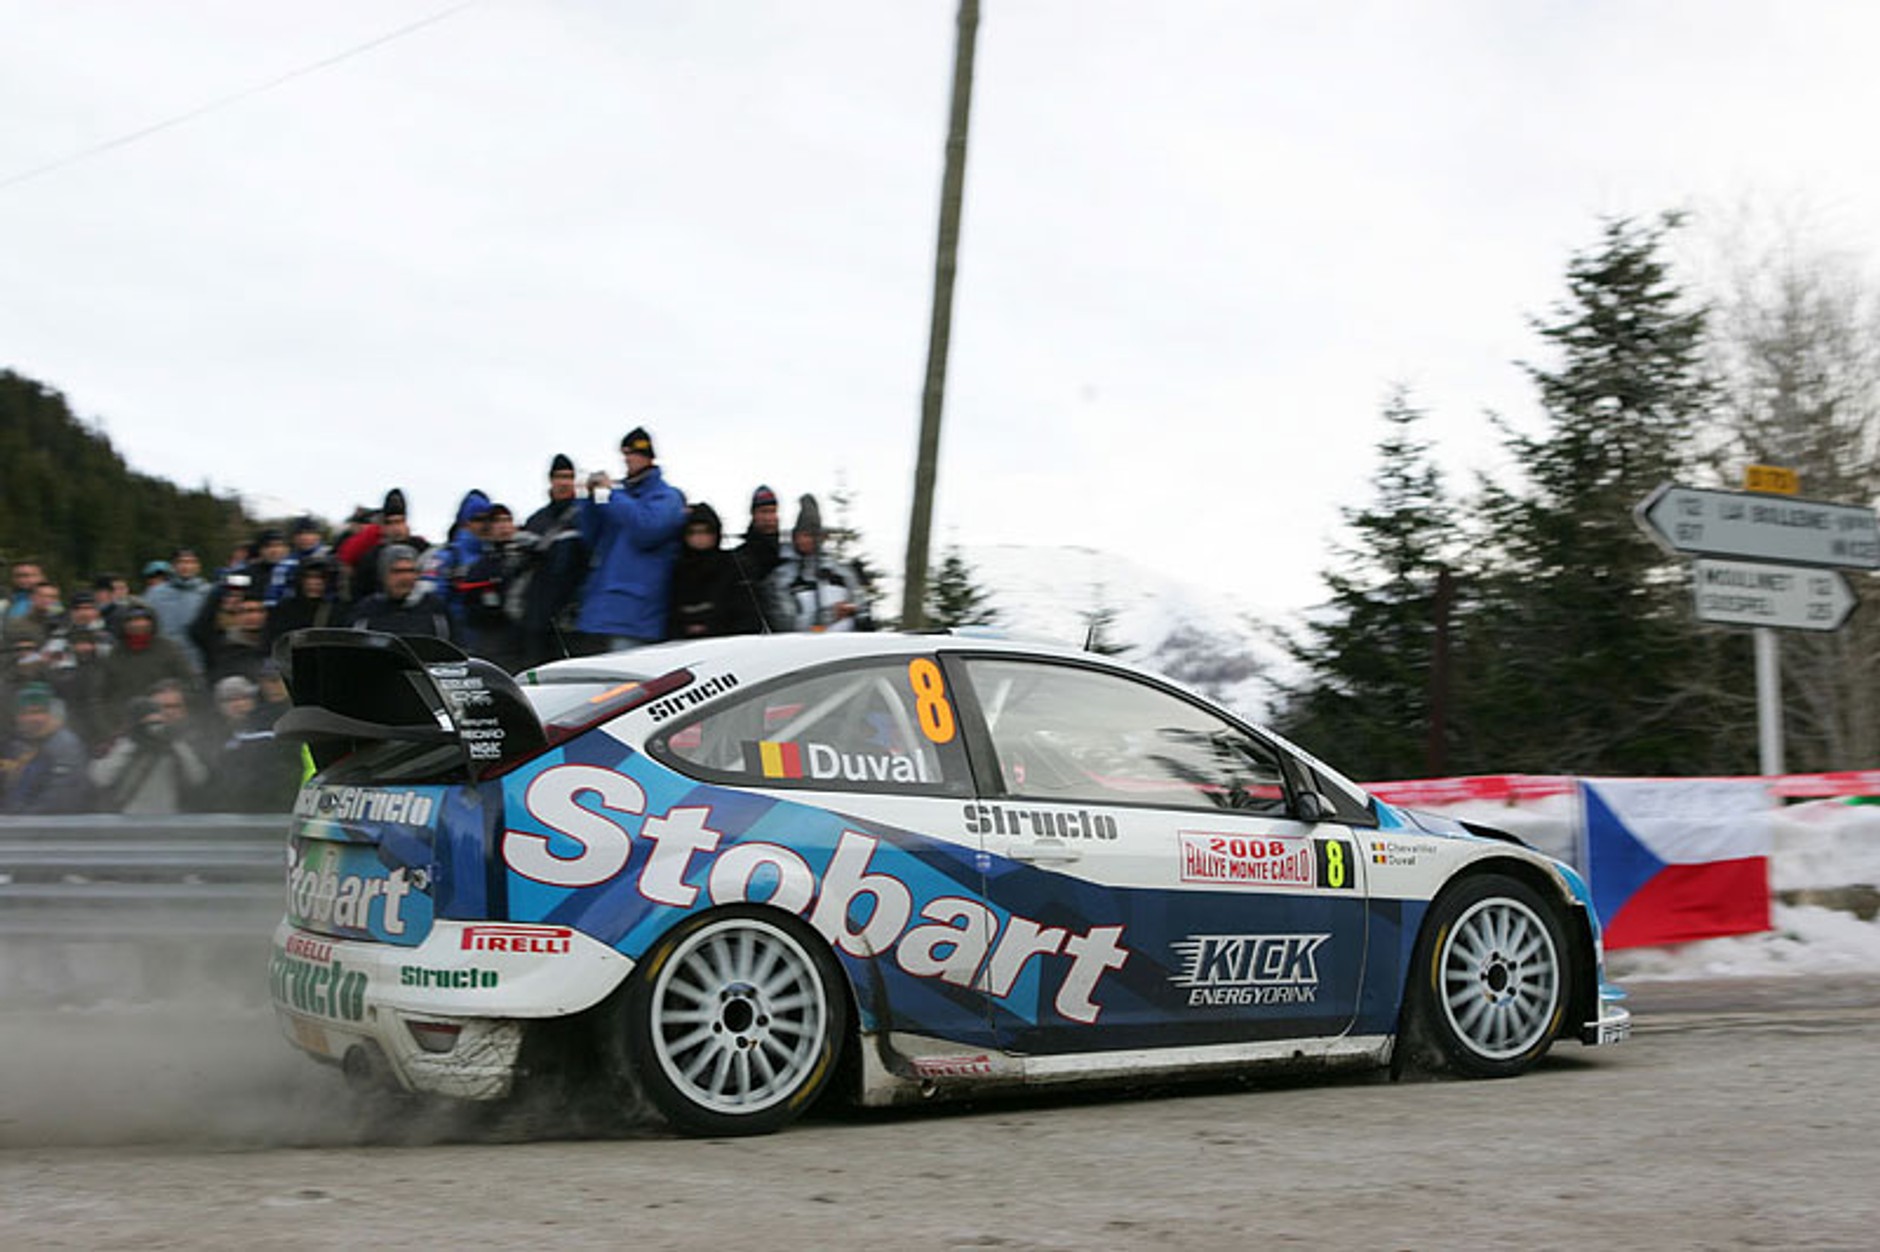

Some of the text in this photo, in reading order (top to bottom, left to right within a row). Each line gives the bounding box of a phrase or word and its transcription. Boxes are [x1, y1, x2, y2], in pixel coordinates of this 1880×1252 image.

[647, 671, 739, 724] Structo
[908, 657, 957, 744] 8
[808, 742, 929, 784] Duval
[338, 786, 432, 826] Structo
[964, 804, 1118, 841] Structo
[1183, 841, 1310, 882] RALLYE MONTE CARLO
[1209, 837, 1286, 859] 2008
[1327, 840, 1345, 888] 8
[502, 763, 1130, 1025] Stobart
[461, 926, 573, 954] PIRELLI
[1178, 934, 1332, 985] KICK
[400, 965, 499, 989] Structo
